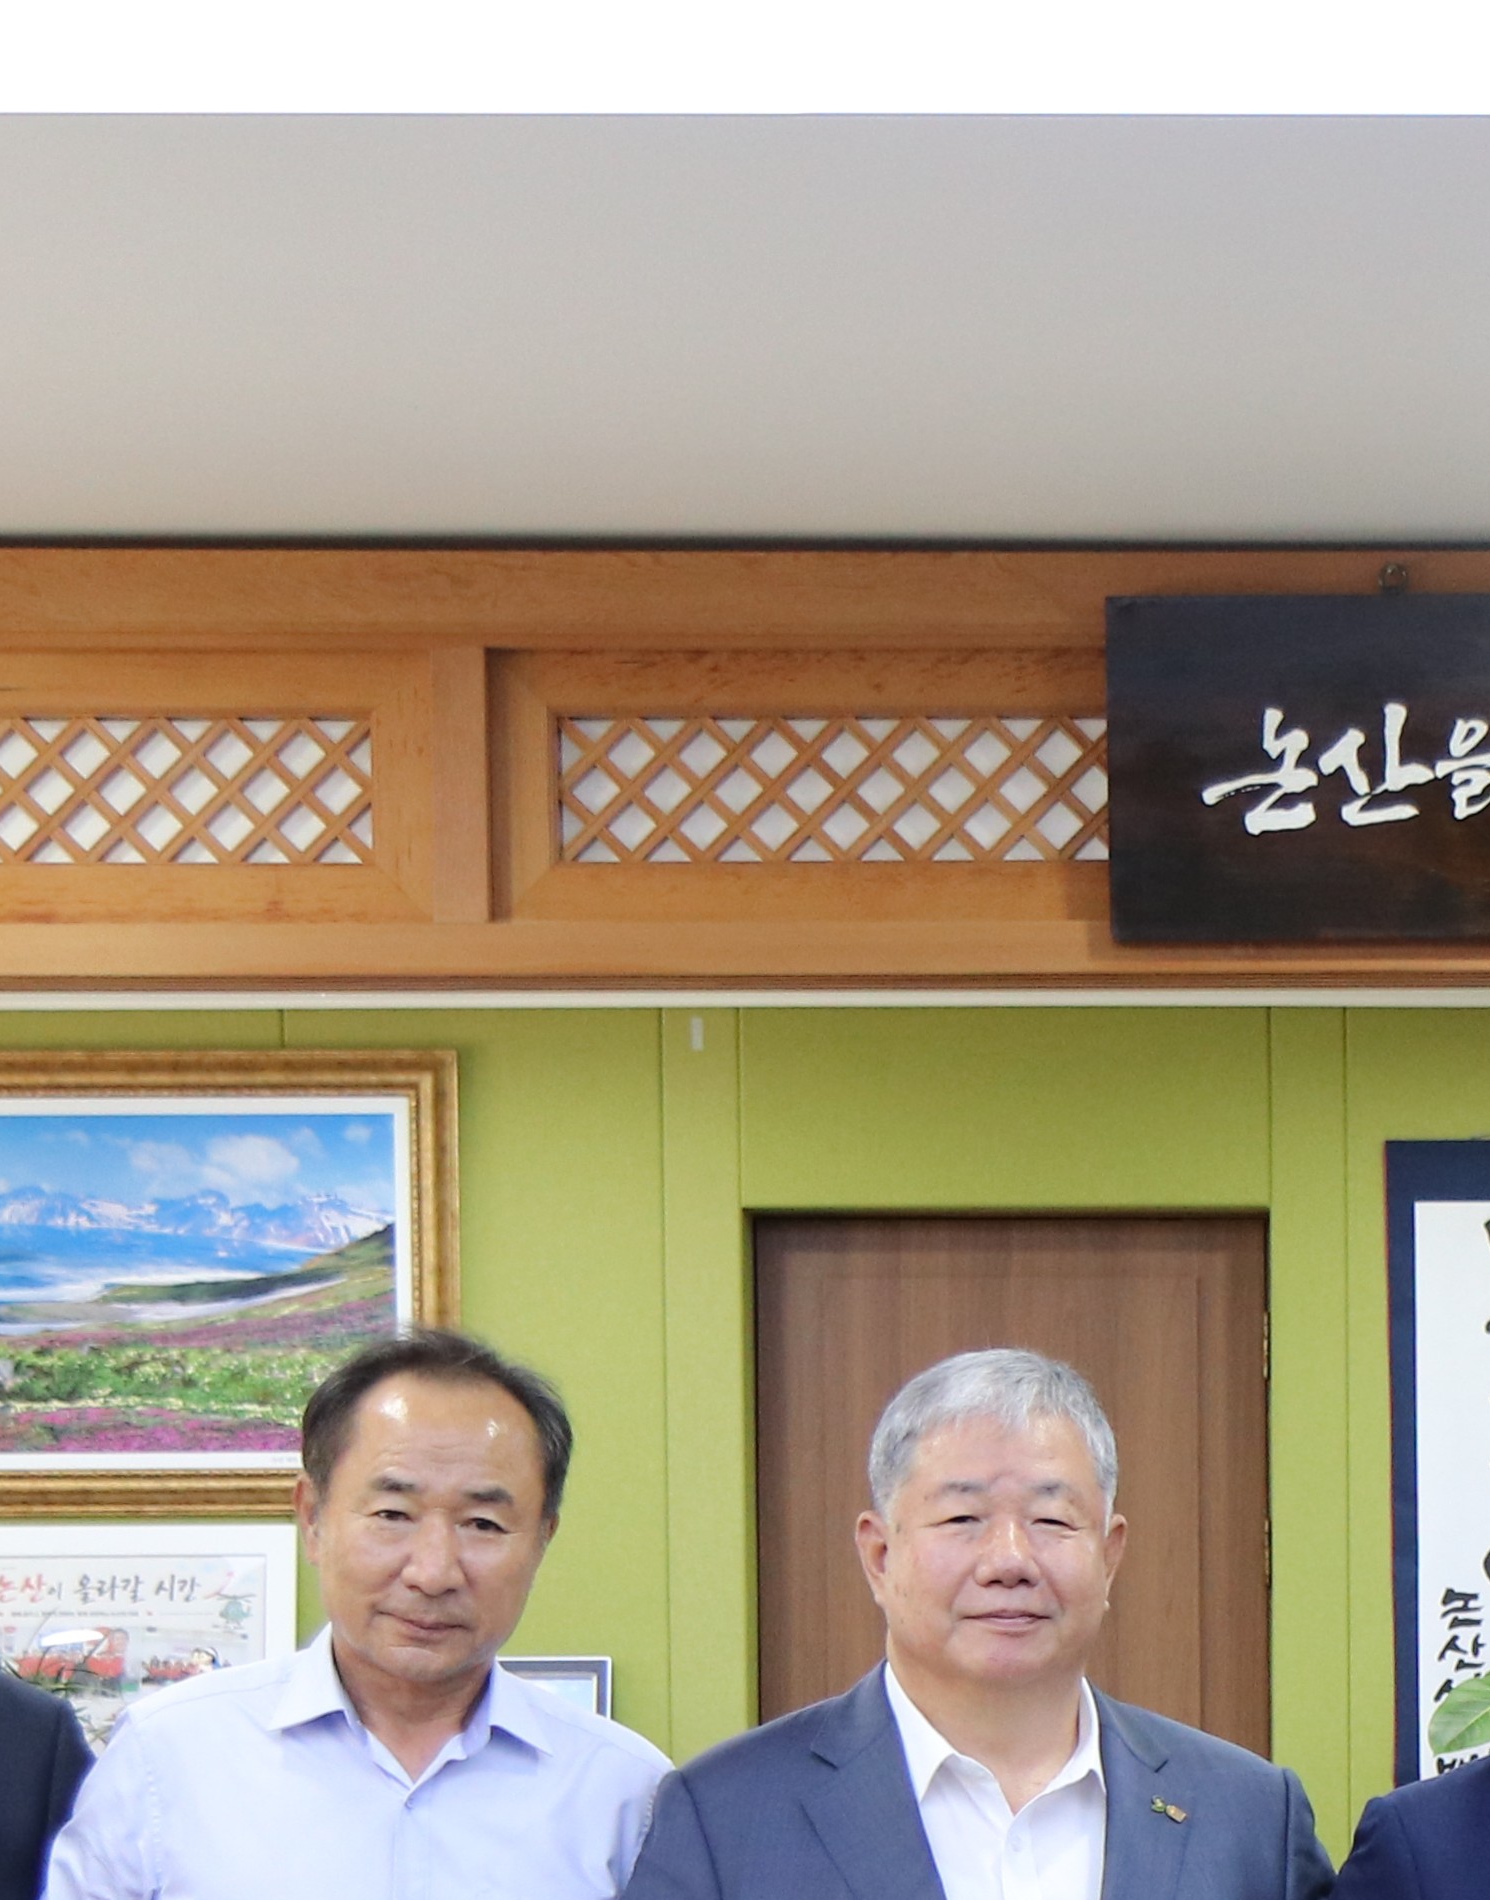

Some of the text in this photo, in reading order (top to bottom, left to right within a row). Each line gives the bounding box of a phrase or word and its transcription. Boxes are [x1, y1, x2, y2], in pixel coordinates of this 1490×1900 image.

[72, 1573, 147, 1605] 올라갈
[153, 1573, 202, 1602] 시간
[1433, 1587, 1488, 1703] 논산
